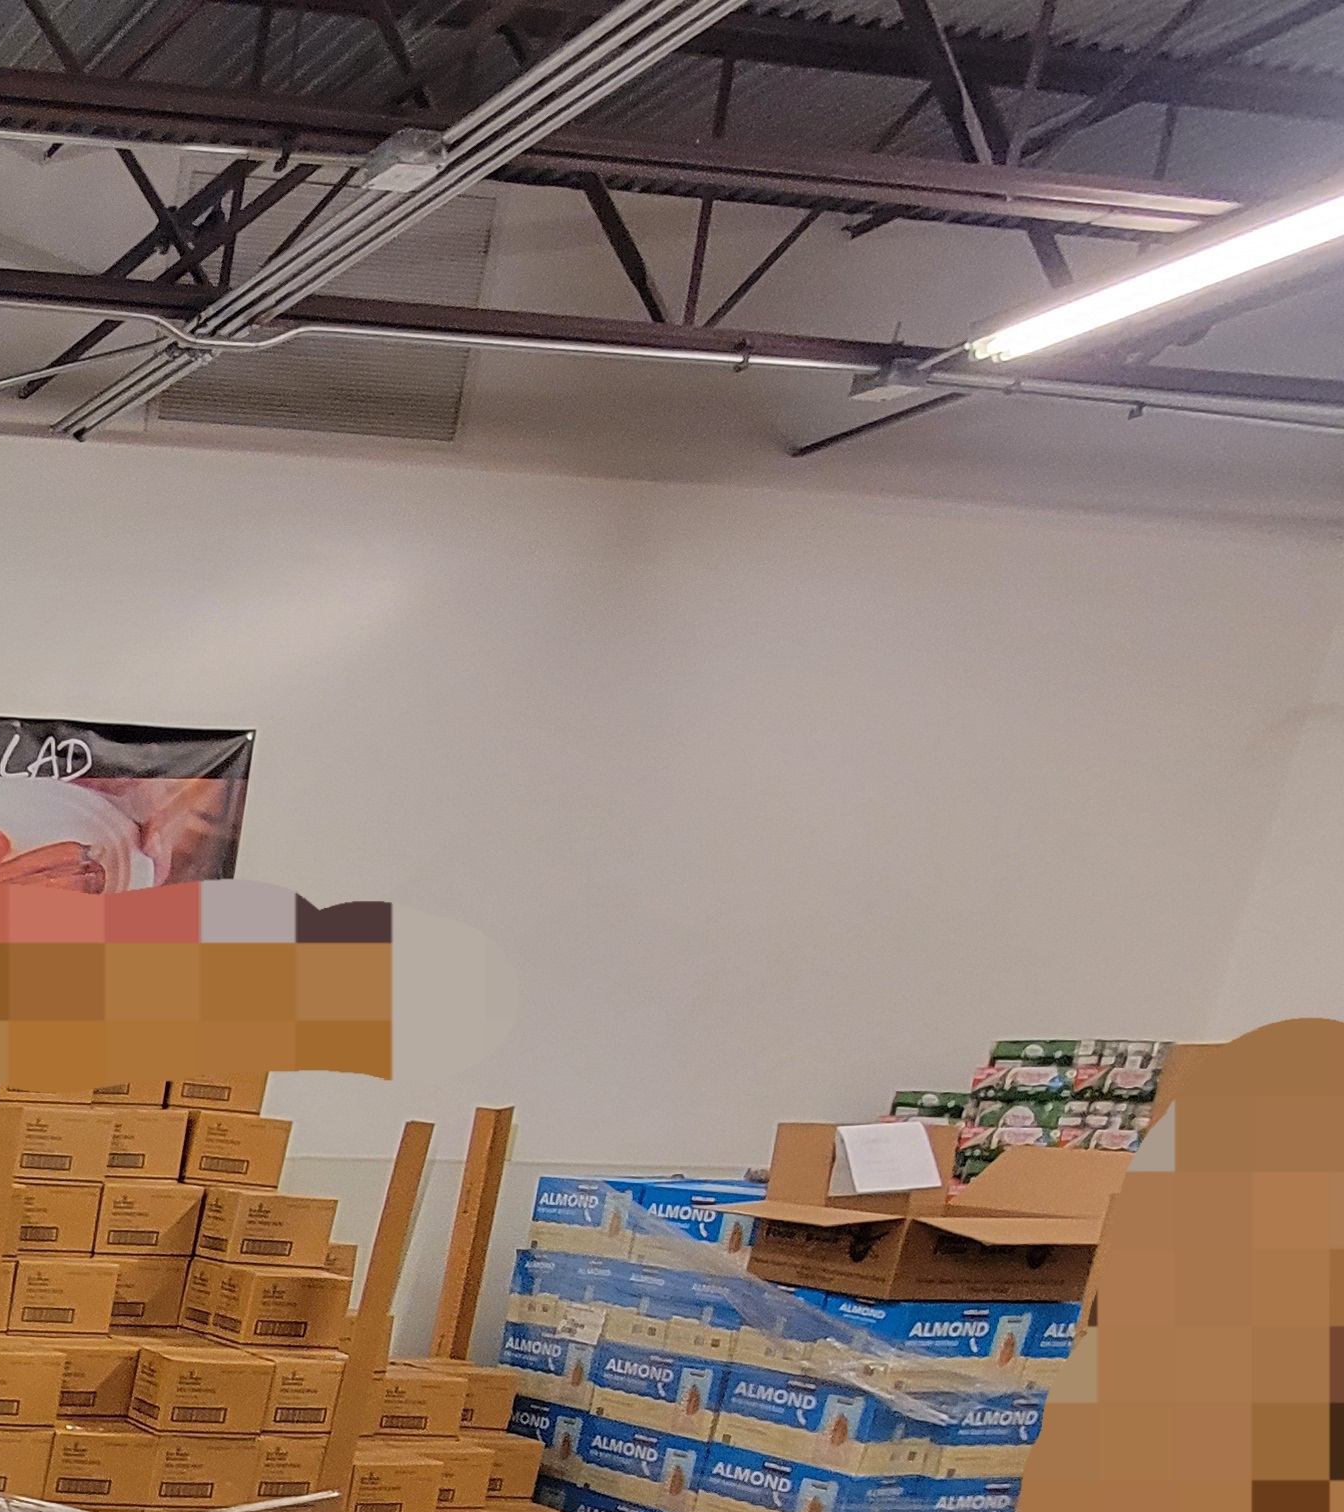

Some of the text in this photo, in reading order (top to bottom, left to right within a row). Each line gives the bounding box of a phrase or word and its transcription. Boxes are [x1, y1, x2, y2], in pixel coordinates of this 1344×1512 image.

[539, 1192, 599, 1209] ALMOND
[647, 1202, 717, 1222] ALMOND
[839, 1304, 886, 1320] ALMOND
[908, 1321, 990, 1338] ALMOND
[1043, 1323, 1078, 1338] ALM
[504, 1336, 562, 1358] ALMOND
[605, 1358, 674, 1382] ALMOND
[733, 1381, 818, 1411] ALMOND
[512, 1410, 550, 1430] MOND
[962, 1411, 1039, 1426] ALMOND
[591, 1435, 659, 1462] ALMOND
[712, 1461, 792, 1493] ALMOND
[934, 1494, 1012, 1511] ALMOND
